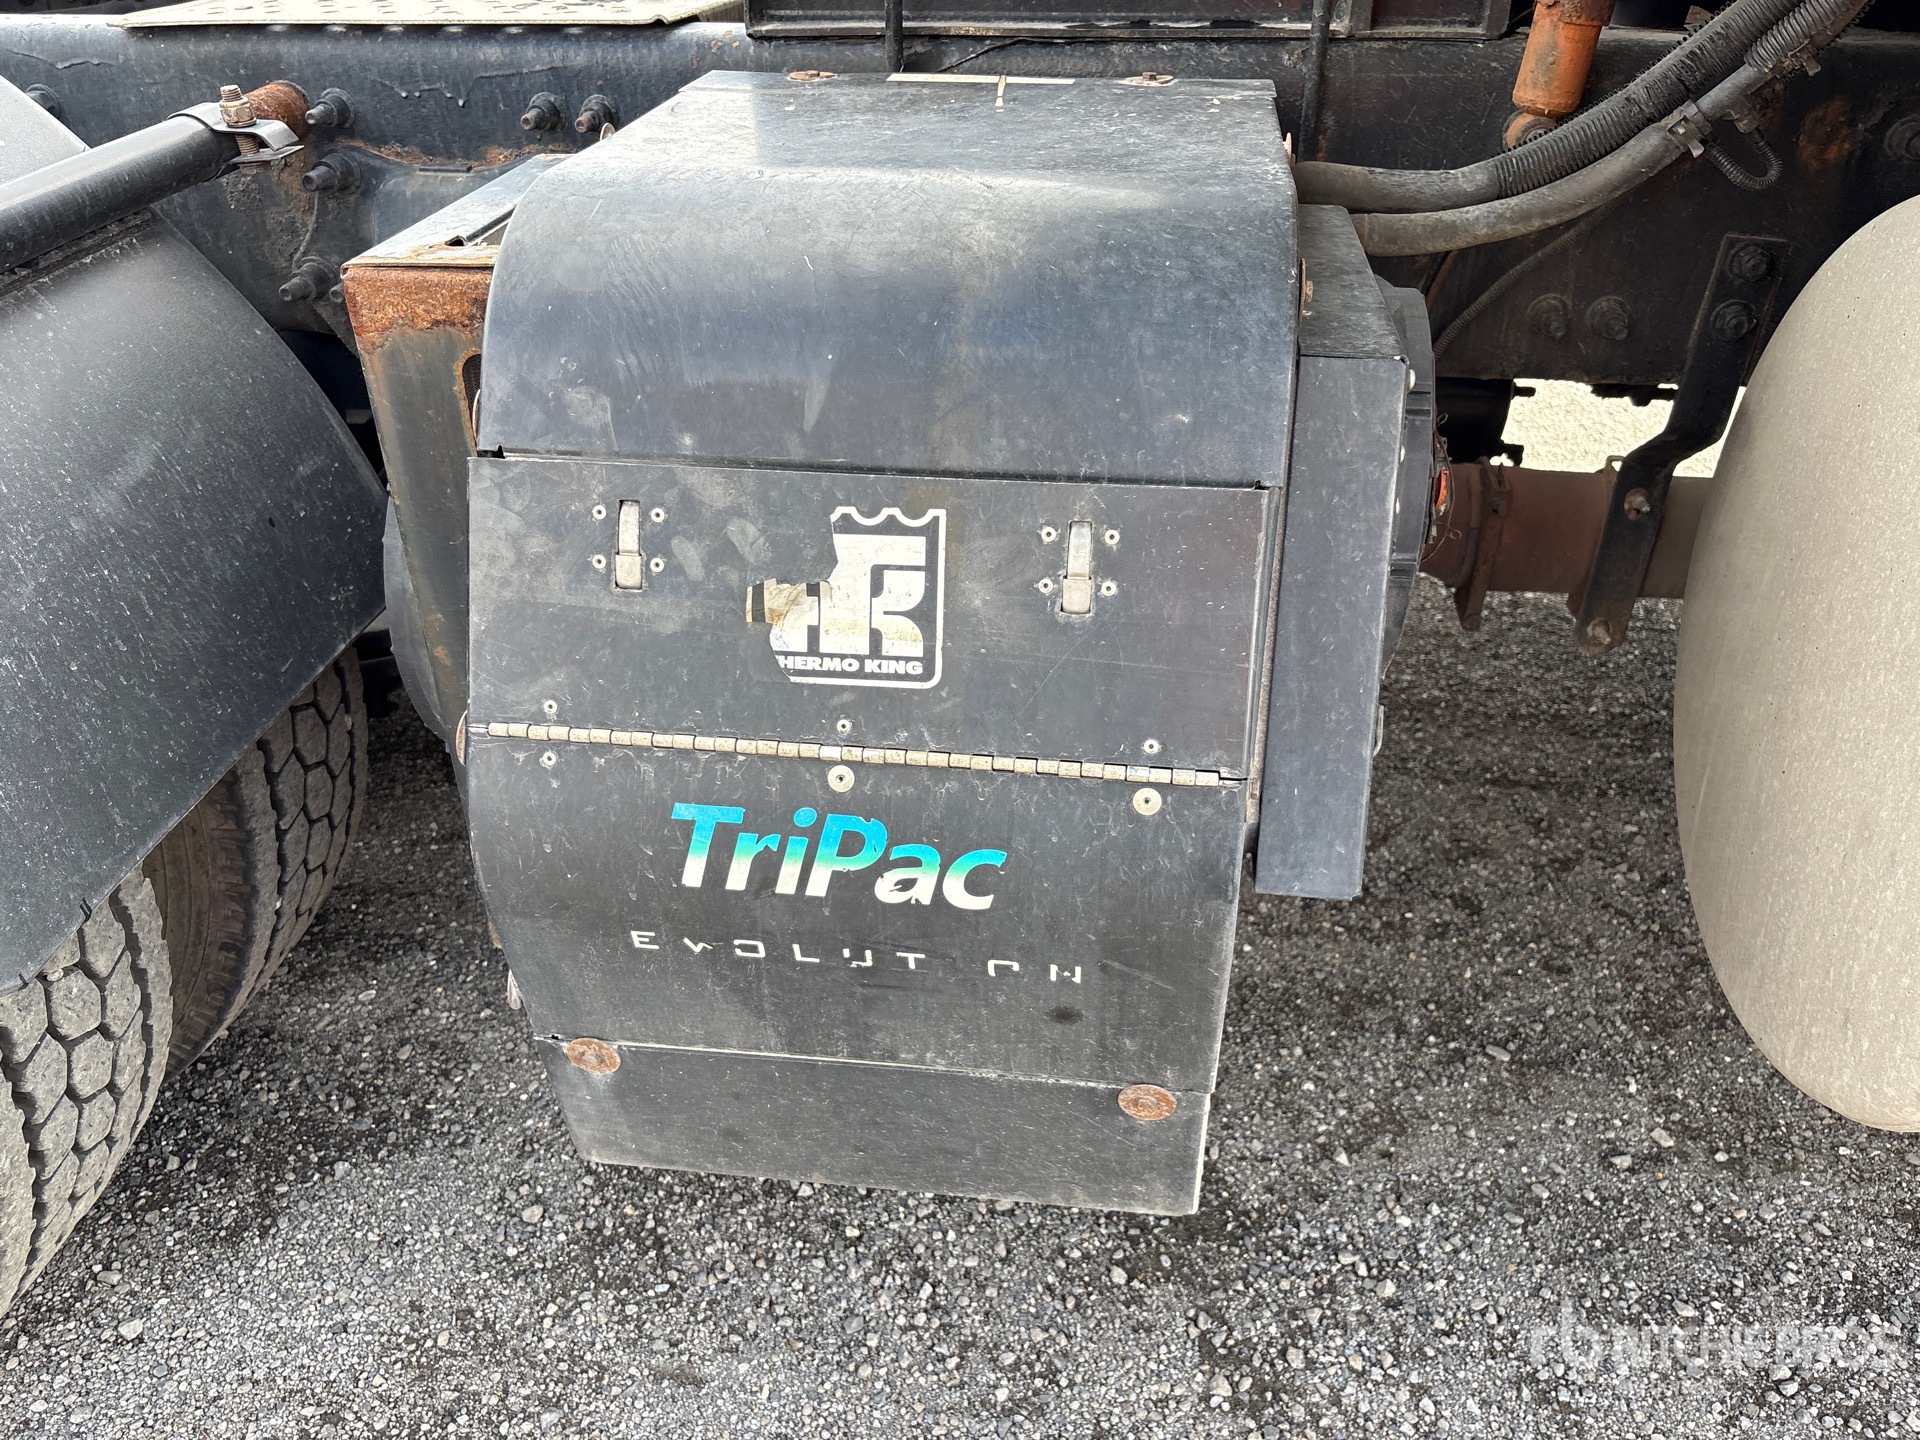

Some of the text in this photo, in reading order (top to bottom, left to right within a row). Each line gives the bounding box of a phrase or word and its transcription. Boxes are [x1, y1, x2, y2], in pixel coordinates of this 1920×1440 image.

[864, 659, 923, 675] KING
[671, 802, 1007, 910] TriPac
[630, 930, 1082, 984] EVOLUTON
